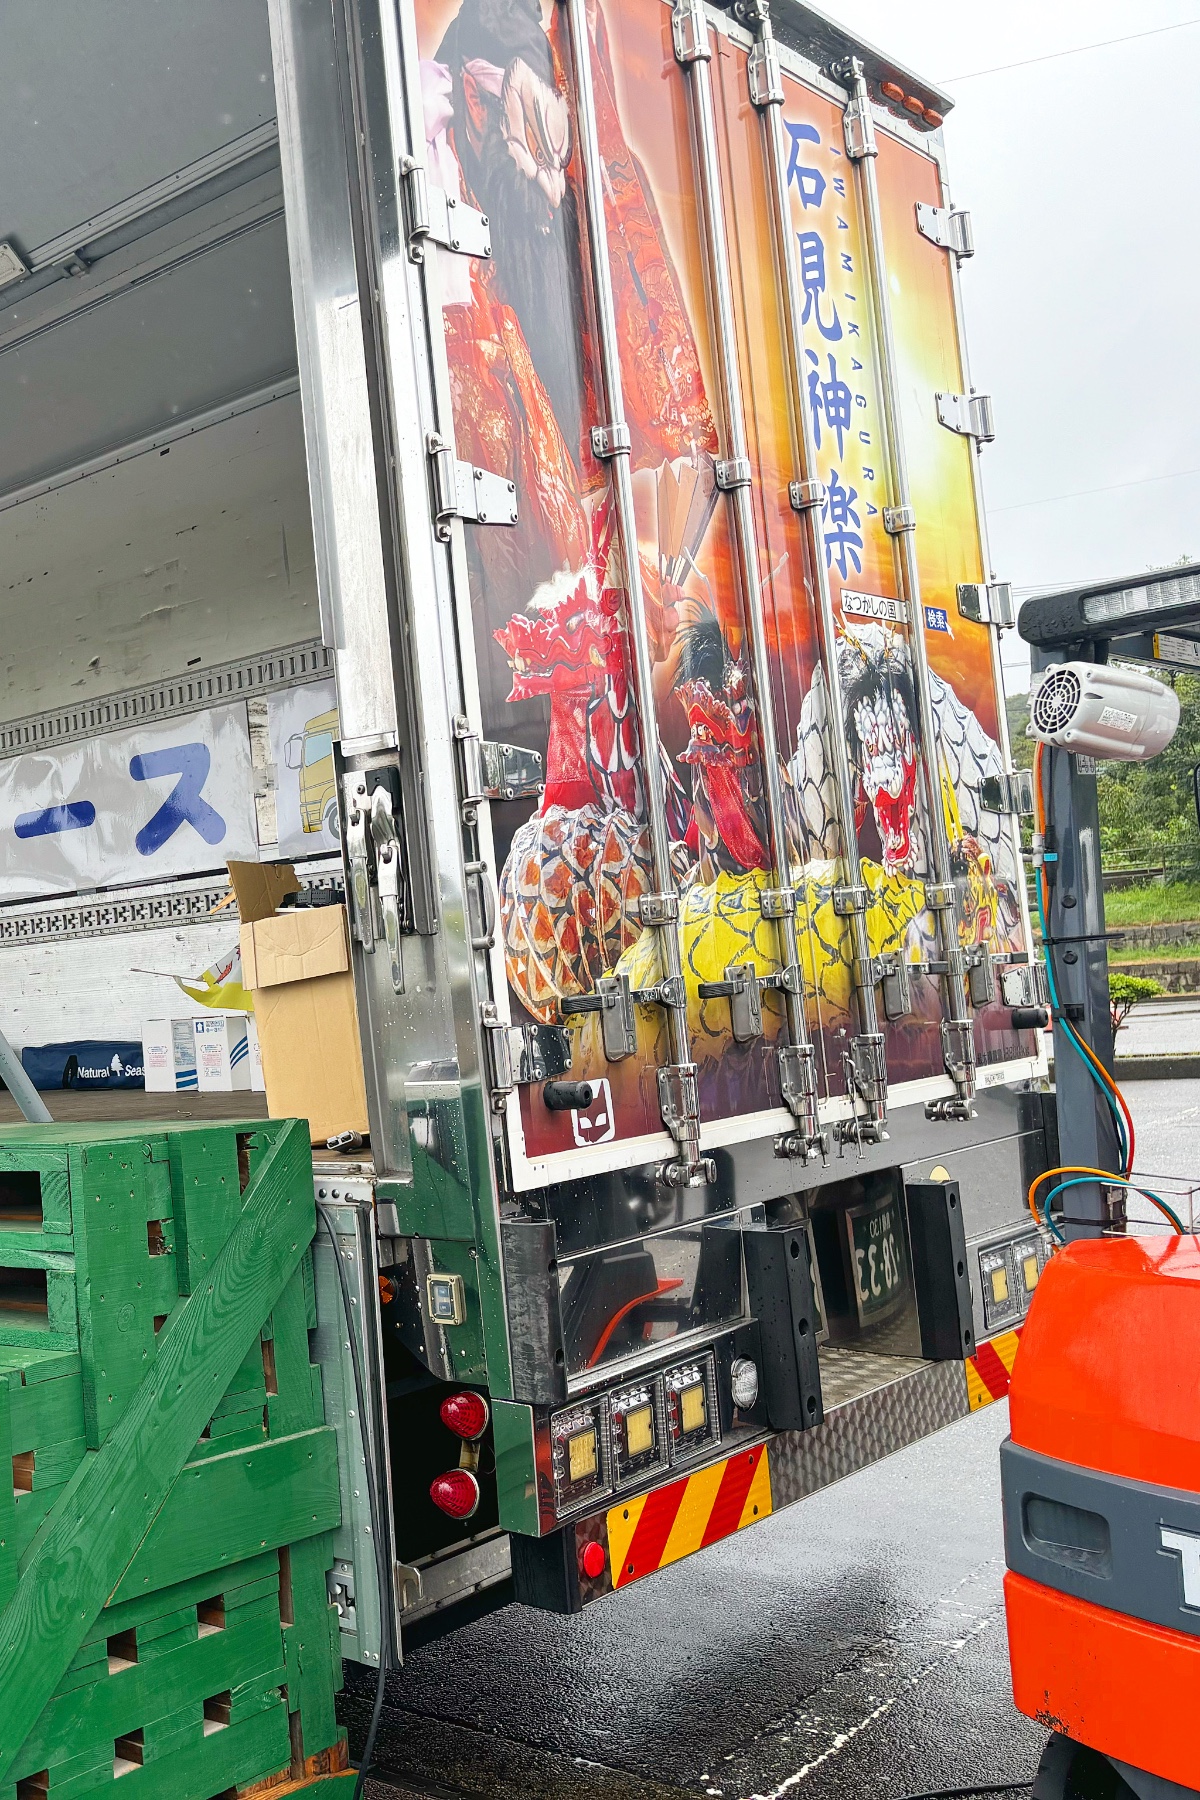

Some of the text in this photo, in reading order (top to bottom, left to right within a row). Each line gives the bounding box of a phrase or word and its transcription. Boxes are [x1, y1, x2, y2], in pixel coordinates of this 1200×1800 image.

[783, 118, 864, 581] 石見神楽
[927, 608, 947, 629] 検索
[77, 1066, 111, 1079] Natural
